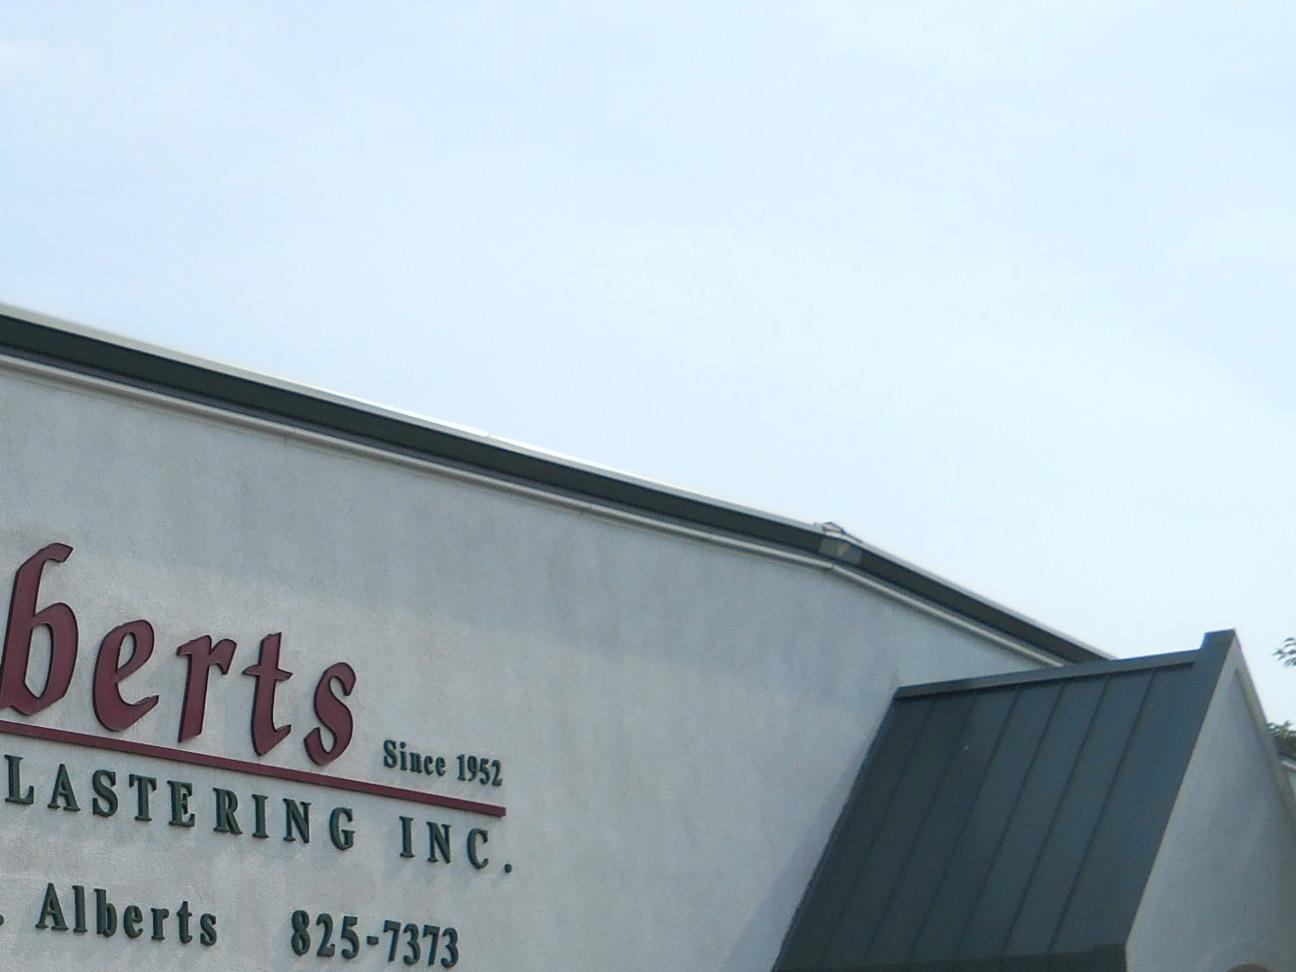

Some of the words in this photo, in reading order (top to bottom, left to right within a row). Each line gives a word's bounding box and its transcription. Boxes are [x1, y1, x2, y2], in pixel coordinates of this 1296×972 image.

[382, 739, 447, 778] Since
[455, 752, 504, 787] 1952
[398, 815, 514, 874] INC.
[35, 882, 218, 947] Alberts
[290, 909, 461, 970] 825-7373
